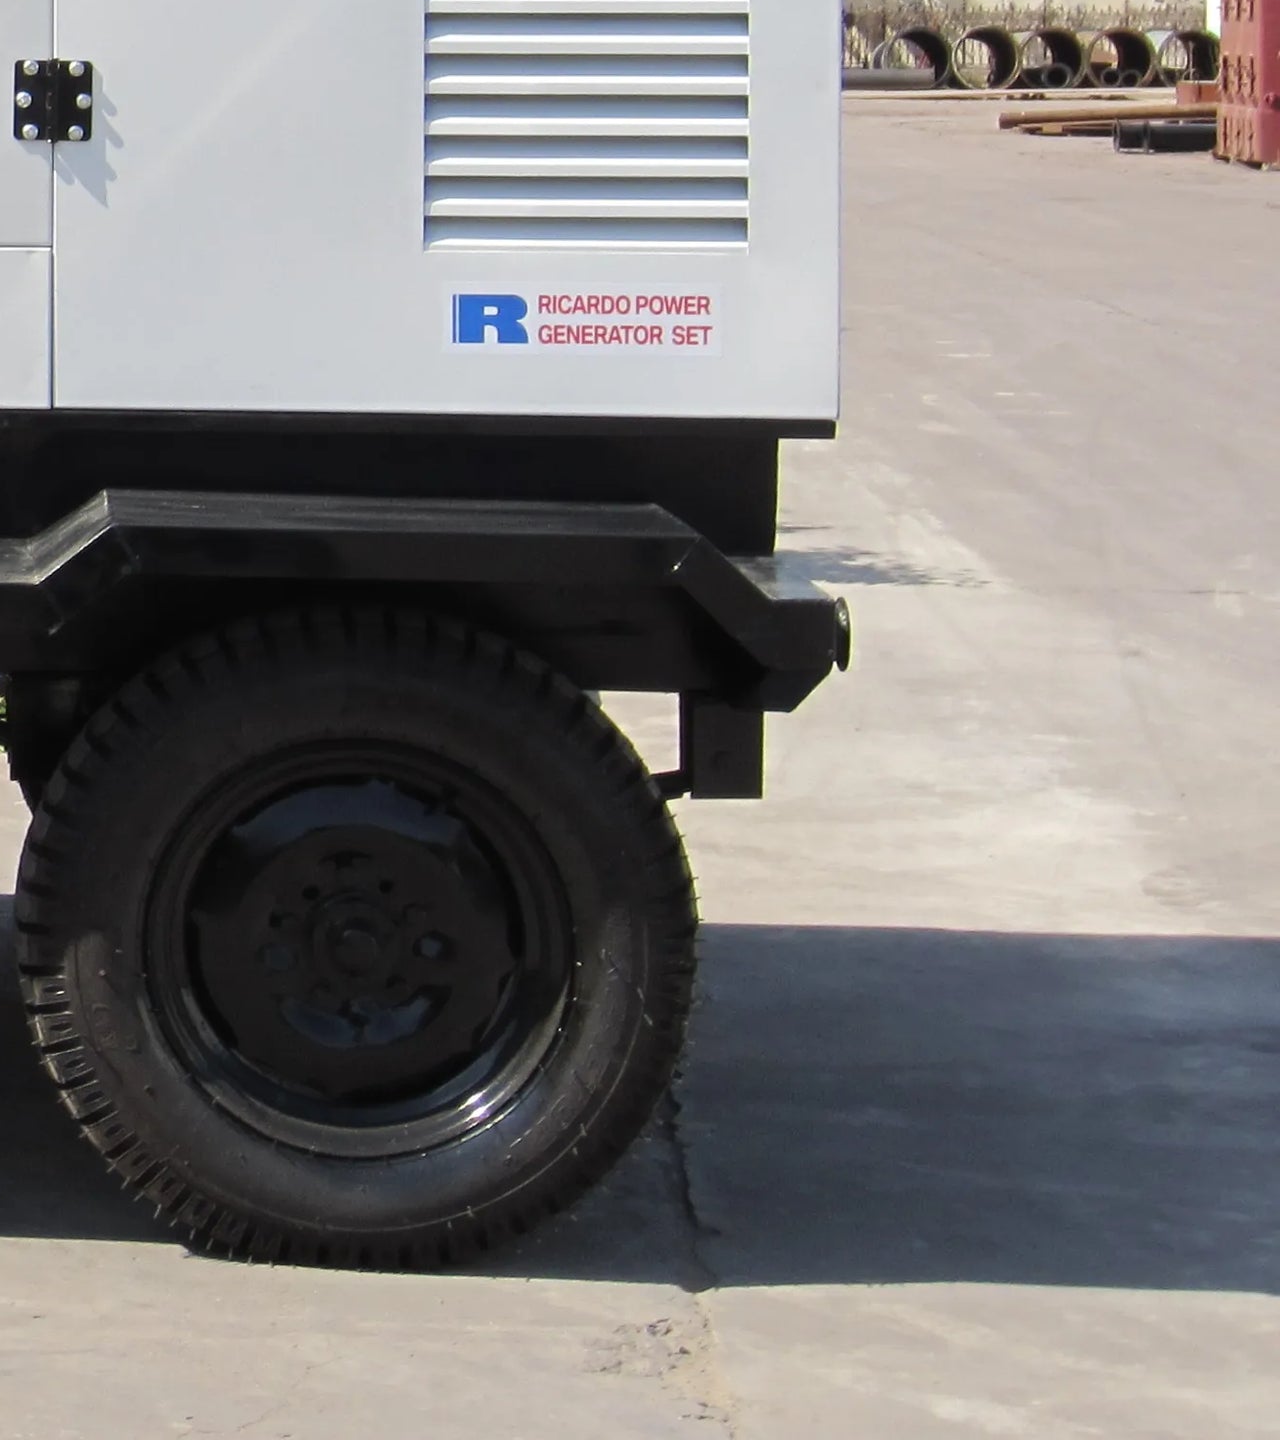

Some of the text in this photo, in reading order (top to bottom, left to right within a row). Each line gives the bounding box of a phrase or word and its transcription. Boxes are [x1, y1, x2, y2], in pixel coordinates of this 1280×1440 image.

[538, 295, 711, 315] RICARDO POWER
[538, 325, 713, 346] GENERATOR SET
